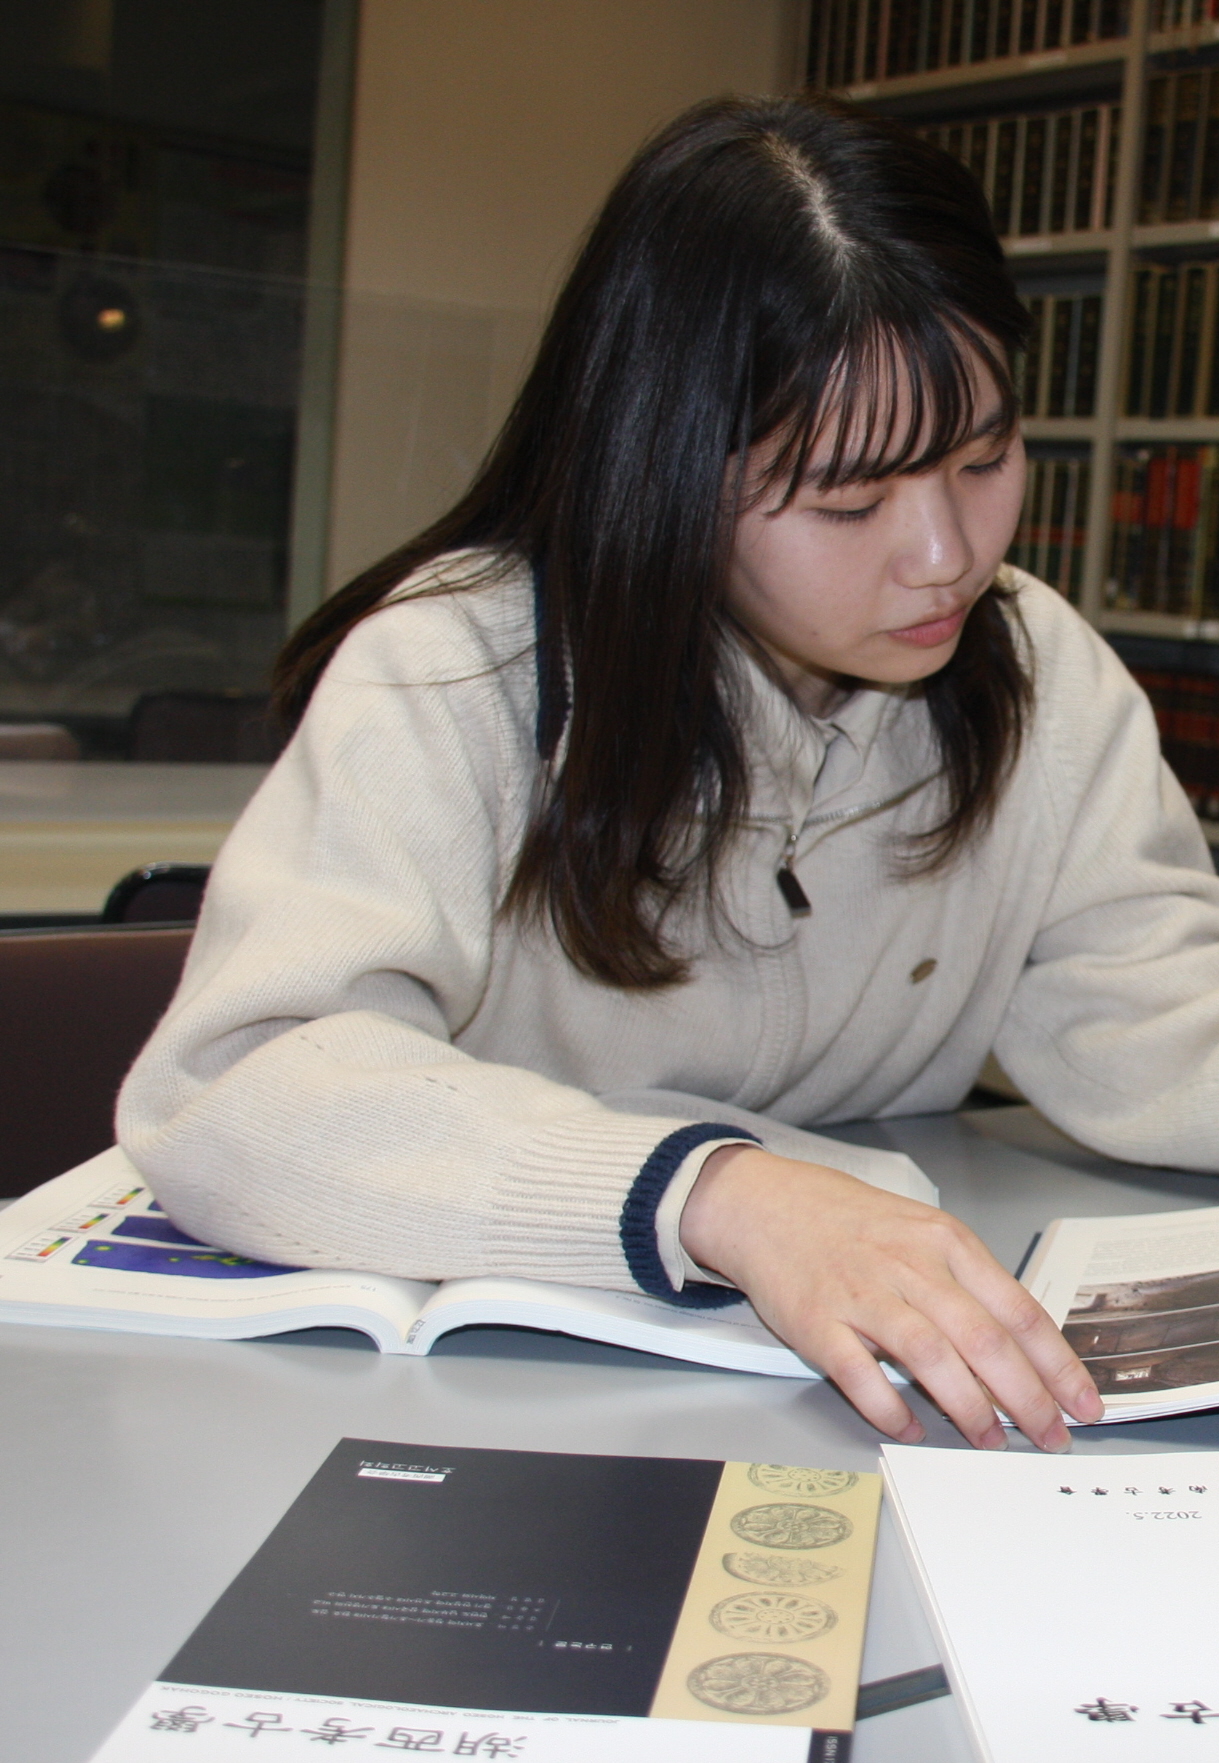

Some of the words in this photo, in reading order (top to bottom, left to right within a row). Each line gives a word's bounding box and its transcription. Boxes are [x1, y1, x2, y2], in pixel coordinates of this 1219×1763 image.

[359, 1460, 456, 1474] 호서고고학회
[1125, 1510, 1203, 1521] 2022.5.
[295, 1696, 344, 1707] SOCIETY
[148, 1706, 530, 1760] 湖西考古學
[823, 1736, 838, 1757] ISSN
